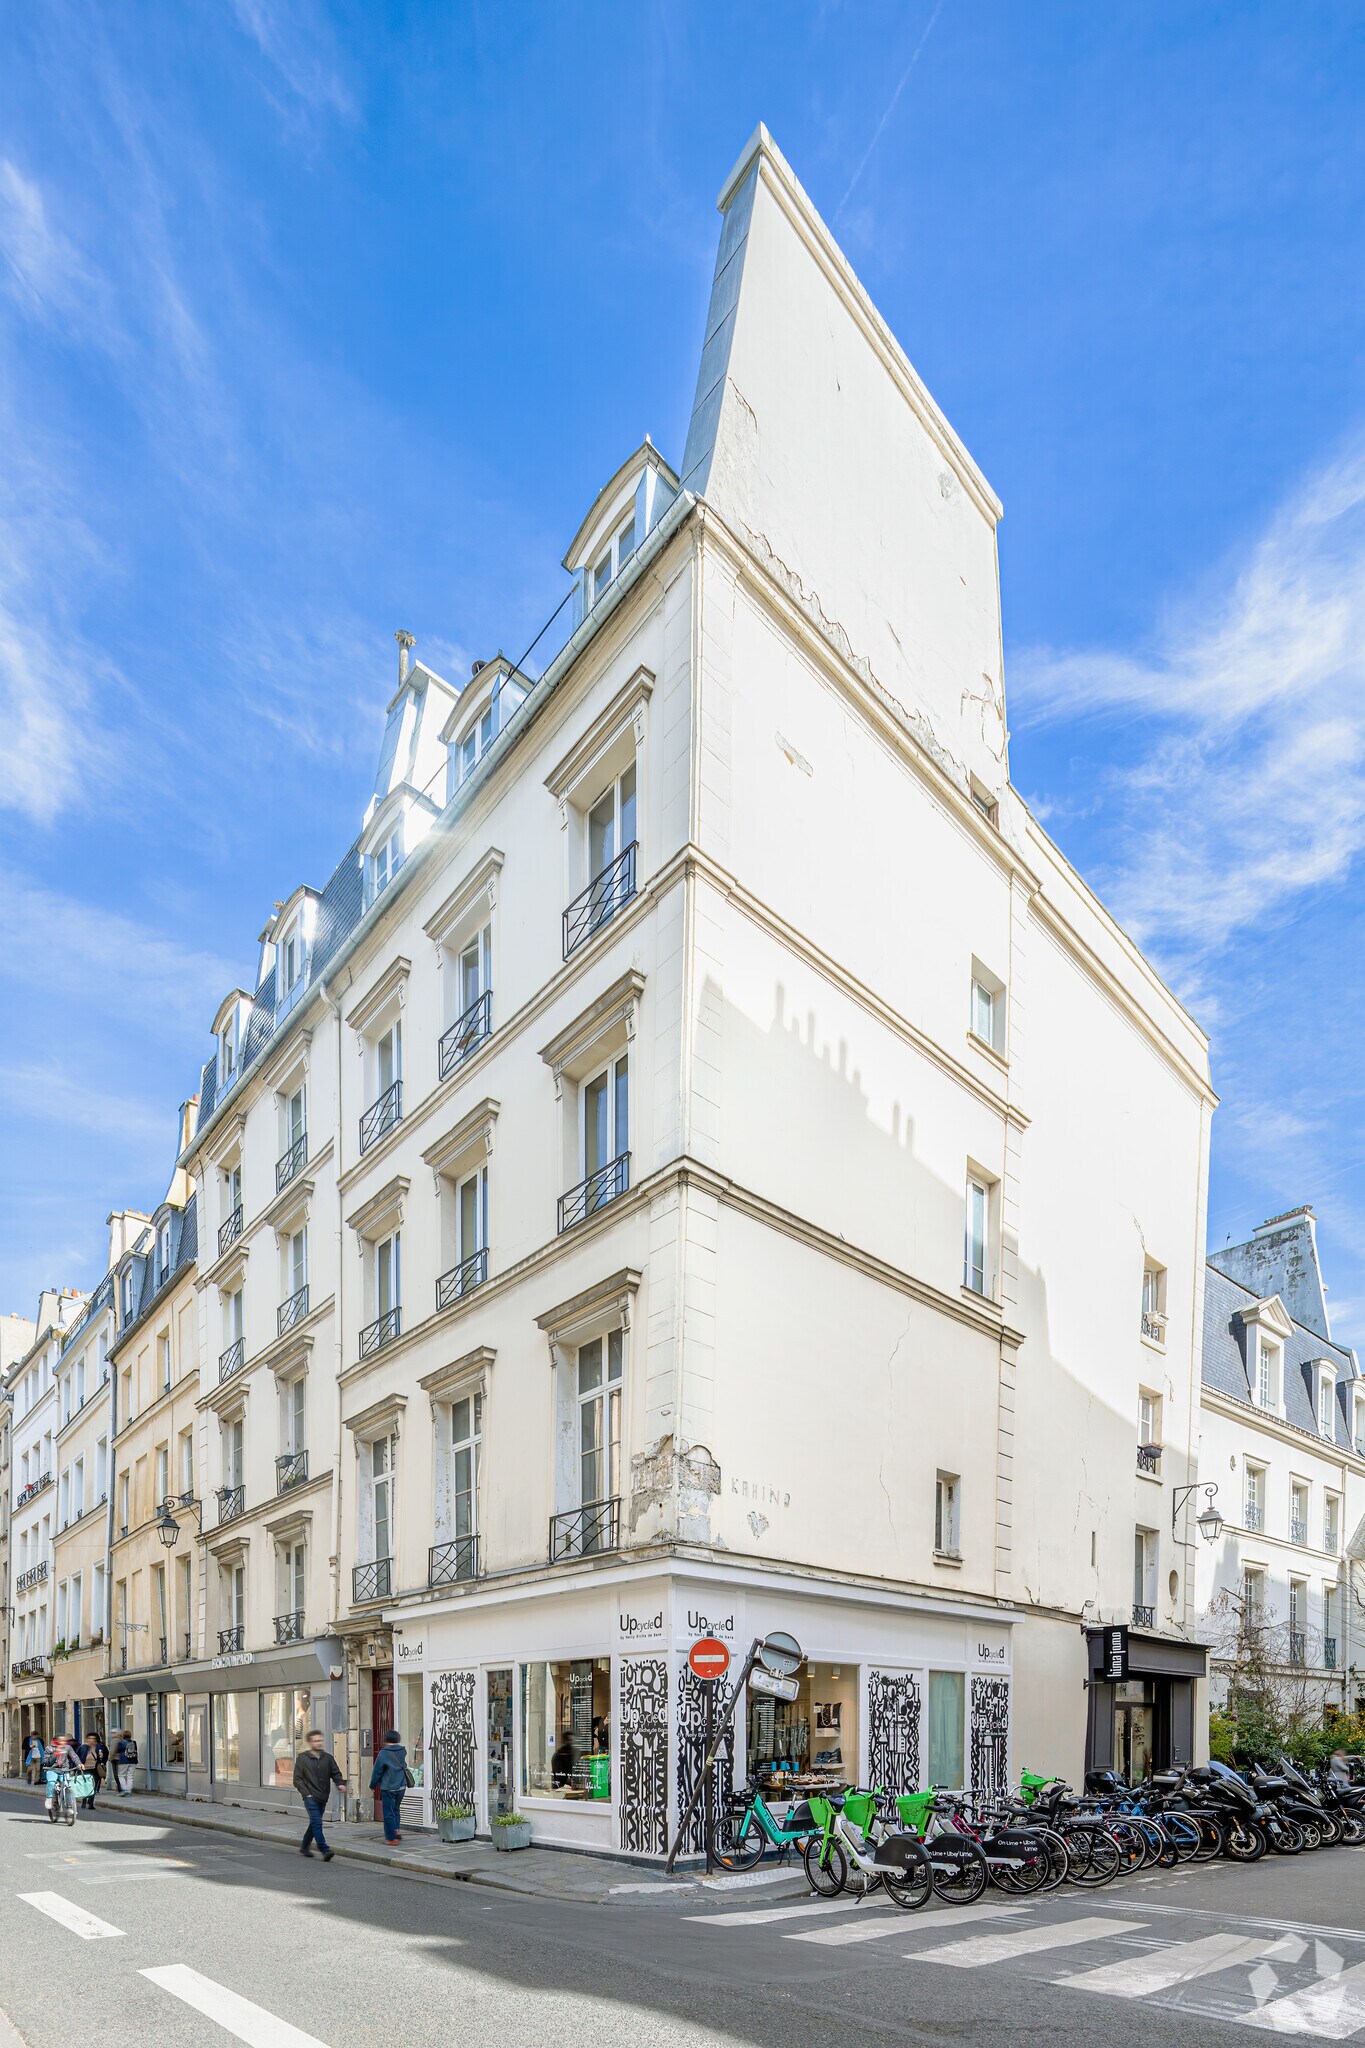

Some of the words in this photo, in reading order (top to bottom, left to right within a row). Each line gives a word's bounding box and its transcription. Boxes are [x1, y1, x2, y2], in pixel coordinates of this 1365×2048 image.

[620, 1611, 663, 1634] Upcycled
[687, 1610, 734, 1633] Upcycled
[1109, 1631, 1126, 1654] jomo
[1106, 1655, 1122, 1677] hima
[621, 1702, 668, 1728] Upcycled
[764, 1811, 778, 1834] TIER
